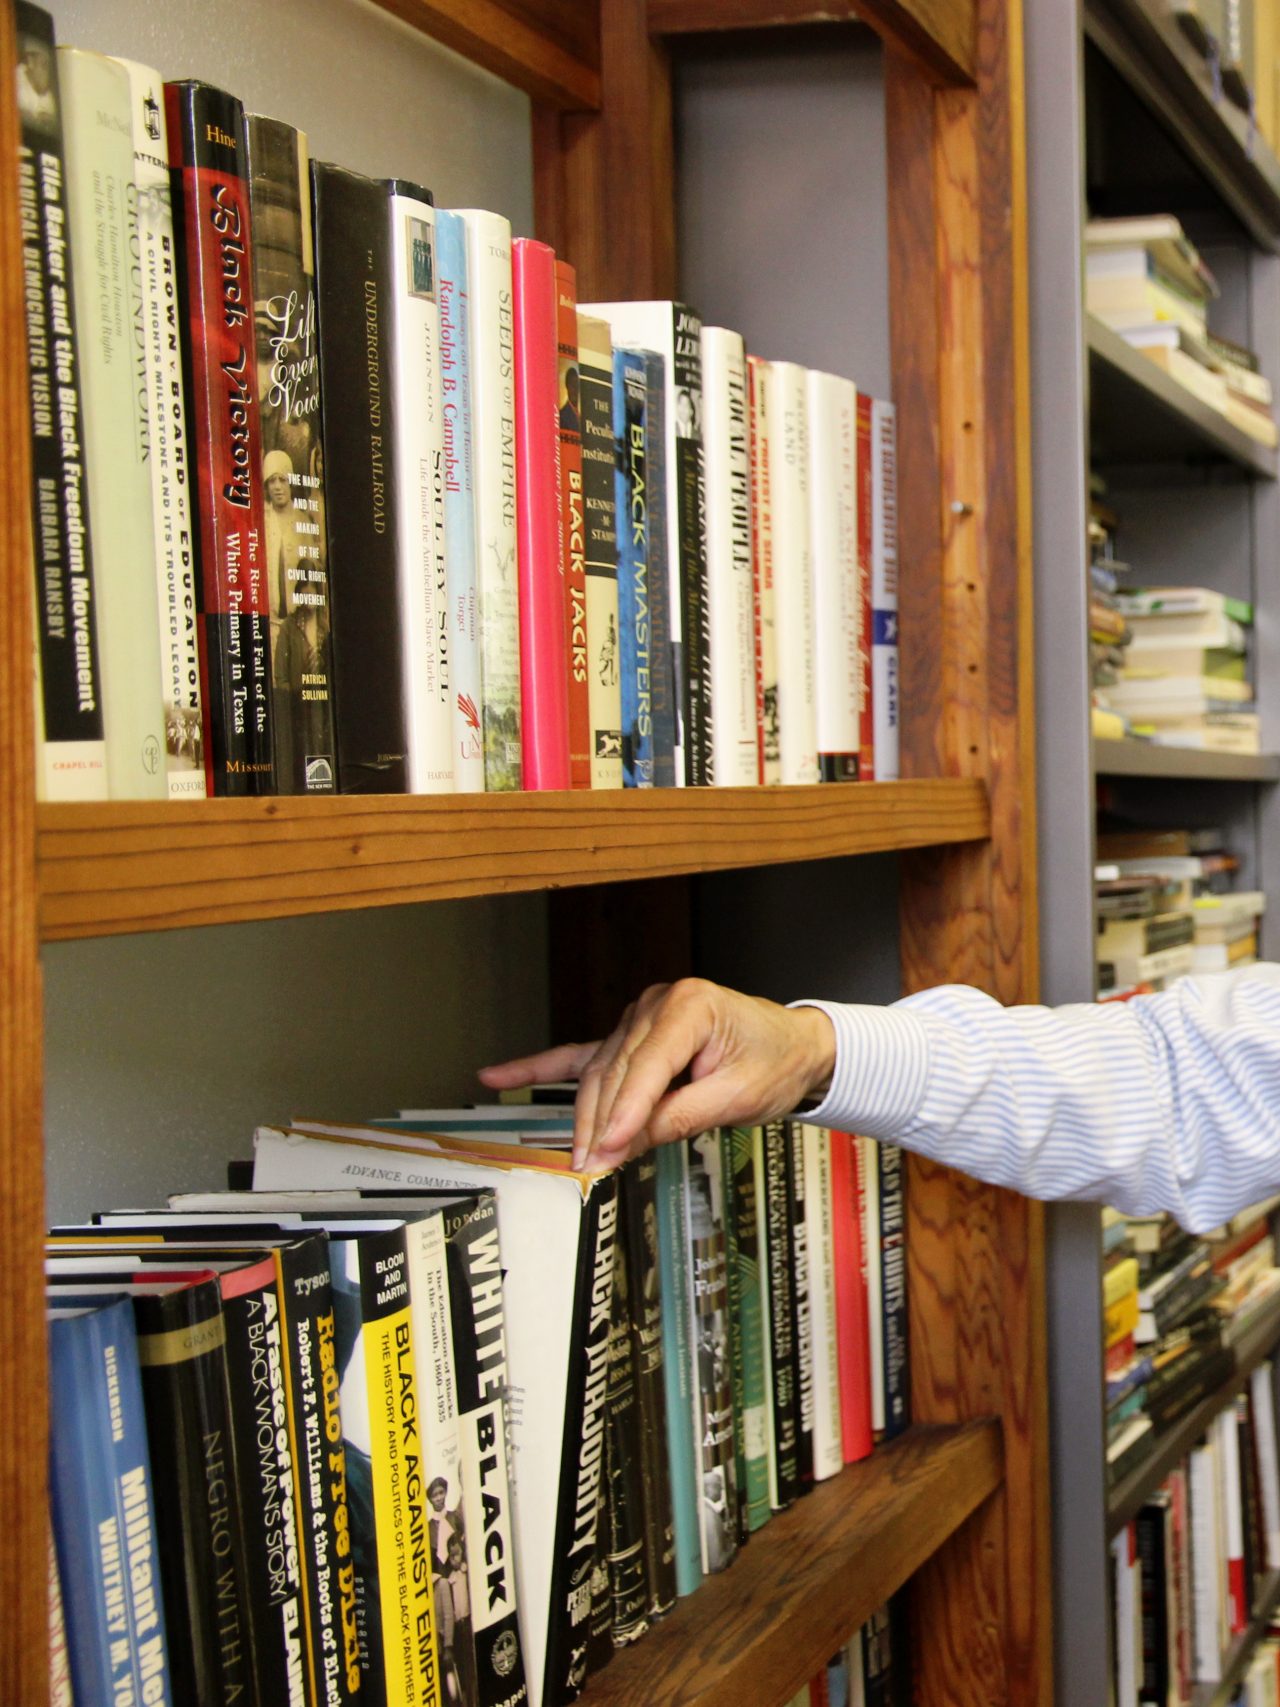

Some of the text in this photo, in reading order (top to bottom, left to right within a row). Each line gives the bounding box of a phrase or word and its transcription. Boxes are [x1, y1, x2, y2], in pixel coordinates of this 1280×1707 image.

[206, 123, 238, 149] Hine
[18, 162, 53, 438] RADICAL DEMOCRATIC VISION
[92, 170, 114, 365] and Struggle Civil Rights
[106, 175, 124, 337] Charles Hamilton Houston
[210, 183, 253, 510] Black Victory
[424, 322, 435, 423] JOHNSON
[439, 278, 460, 493] Randolph B. Campbell
[41, 152, 96, 712] Ella Baker and the Black Freedom Movement
[364, 279, 386, 535] UNDERGROUND RAILROAD
[499, 289, 515, 527] SEEDS OF EMPIRE
[593, 398, 610, 413] THE
[729, 380, 746, 460] LOCAL
[784, 410, 797, 466] LAND
[148, 247, 182, 709] CIVIL RIGHTS MILESTONE AND ITS TROUBLED LEGACY
[161, 235, 198, 709] BROWN BOARD OF EDUCATION
[287, 473, 321, 489] THE NAACP
[293, 498, 320, 513] AND THE
[553, 434, 565, 577] Empire Slavery
[731, 470, 750, 571] PEOPLE
[38, 478, 64, 639] BARBARA RANSBY
[287, 568, 327, 584] CIVIL RIGHTS
[296, 521, 320, 535] MAKING
[298, 546, 320, 559] OF THE
[419, 458, 435, 694] Life Inside the Antebellum Slave Market
[431, 450, 449, 702] SOUL BY SOUL
[567, 471, 587, 683] BLACK JACKS
[247, 528, 267, 733] The Rise and Fall of the
[292, 593, 326, 607] MOVEMENT
[630, 423, 652, 737] BLACK MASTERS
[687, 587, 700, 674] Movement
[225, 531, 247, 735] White Primary in Texas
[302, 673, 327, 685] PATRICIA
[302, 689, 328, 701] SULLIVAN
[690, 696, 699, 786] Simon Schuster
[888, 655, 897, 727] CLARK
[170, 780, 206, 793] OXFORD
[340, 1164, 402, 1182] ADVANCE
[819, 1158, 829, 1236] AMERICANS
[294, 1267, 330, 1297] Tyson
[376, 1252, 405, 1275] BLOOM
[376, 1282, 408, 1306] MARTIN
[384, 1269, 402, 1288] AND
[590, 1196, 617, 1335] BLACK
[882, 1190, 905, 1314] THE COURTS
[183, 1325, 222, 1350] GRANT
[297, 1317, 315, 1390] Robert
[430, 1310, 441, 1354] South,
[434, 1266, 453, 1419] The Education Blacks
[467, 1227, 508, 1400] WHITE
[793, 1221, 815, 1433] BLACK LIBERATION
[104, 1345, 125, 1443] DICKERSON
[262, 1292, 300, 1589] A Taste of Power
[303, 1391, 317, 1412] F.
[246, 1299, 288, 1597] A BLACK WOMAN'S STORY
[305, 1412, 323, 1509] Williams
[395, 1321, 429, 1600] BLACK AGAINST
[566, 1336, 609, 1557] MAJORITY
[120, 1464, 159, 1638] Militant
[312, 1512, 326, 1529] &
[314, 1530, 329, 1566] the
[317, 1308, 360, 1694] Radio Free Dixie
[381, 1331, 415, 1703] THE HISTORY AND POLITICS OF THE BLACK PANTHER
[476, 1410, 508, 1613] BLACK
[98, 1515, 130, 1673] WHITNEY M.
[203, 1430, 244, 1705] NEGRO WITH A
[317, 1566, 334, 1625] Roots
[322, 1627, 336, 1651] of
